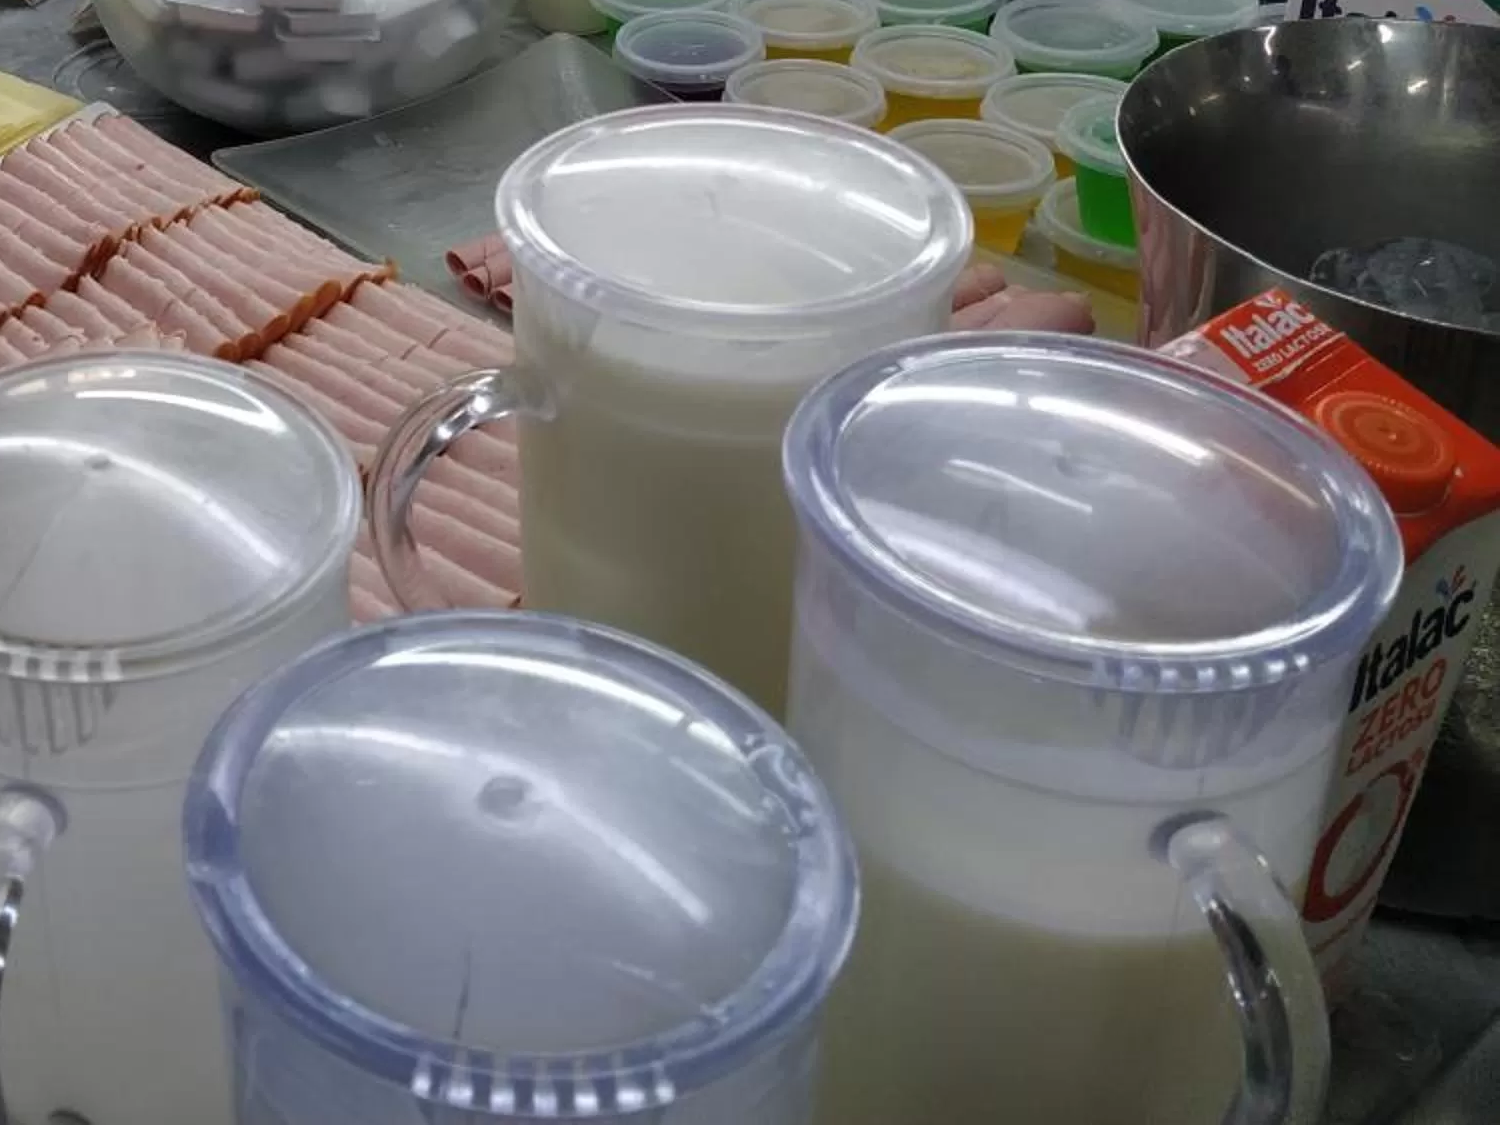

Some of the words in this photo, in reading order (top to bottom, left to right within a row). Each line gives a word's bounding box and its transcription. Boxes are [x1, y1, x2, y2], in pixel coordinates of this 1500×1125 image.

[1219, 302, 1315, 359] Italac
[1348, 588, 1475, 713] Italac
[1351, 657, 1447, 753] ZERO
